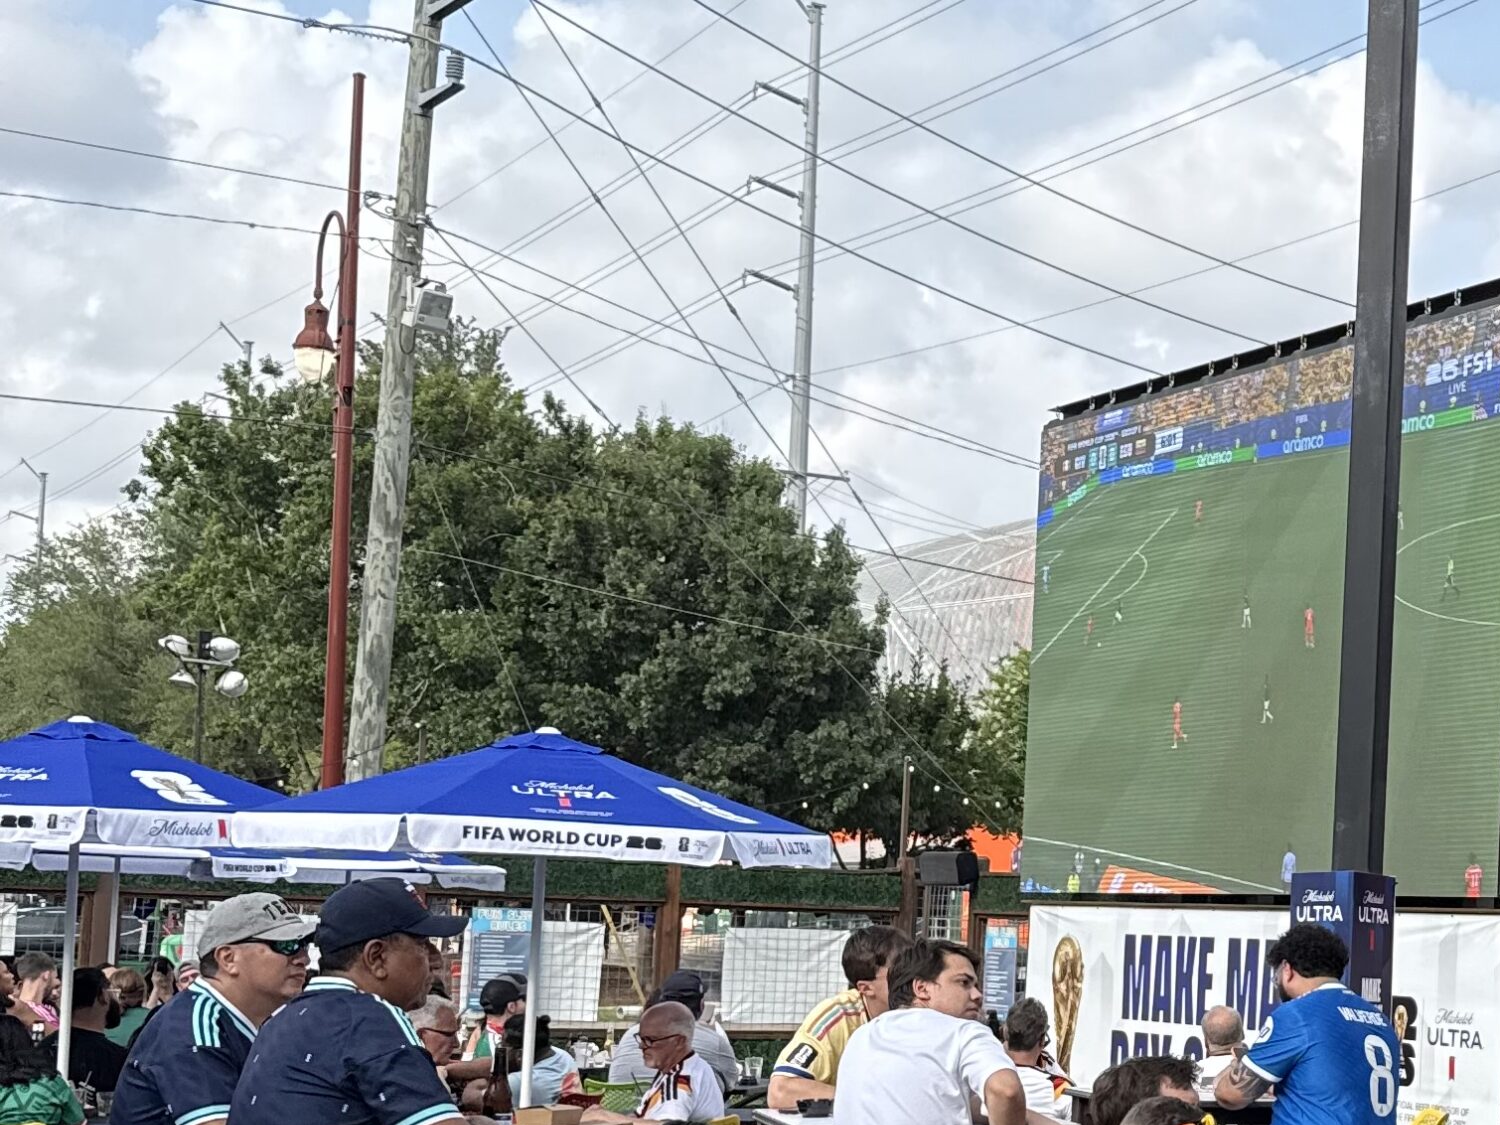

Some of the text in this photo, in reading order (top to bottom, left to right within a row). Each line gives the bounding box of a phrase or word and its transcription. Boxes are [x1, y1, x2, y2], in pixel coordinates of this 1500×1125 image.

[1463, 349, 1493, 377] FS1
[1448, 381, 1467, 395] LIVE
[1401, 414, 1435, 433] amco
[1283, 435, 1324, 454] aramco
[511, 785, 619, 799] ULTRA
[149, 818, 213, 838] Michelob
[462, 825, 505, 841] FIFA
[508, 827, 580, 845] WORLD
[584, 833, 622, 847] CUP
[784, 842, 812, 855] ULTRA
[1296, 905, 1343, 922] ULTRA
[1358, 906, 1389, 924] ULTRA
[1122, 934, 1215, 1026] MAKE
[1435, 1008, 1474, 1025] Michelob
[1427, 1027, 1484, 1050] ULTRA
[1364, 1034, 1396, 1117] 8
